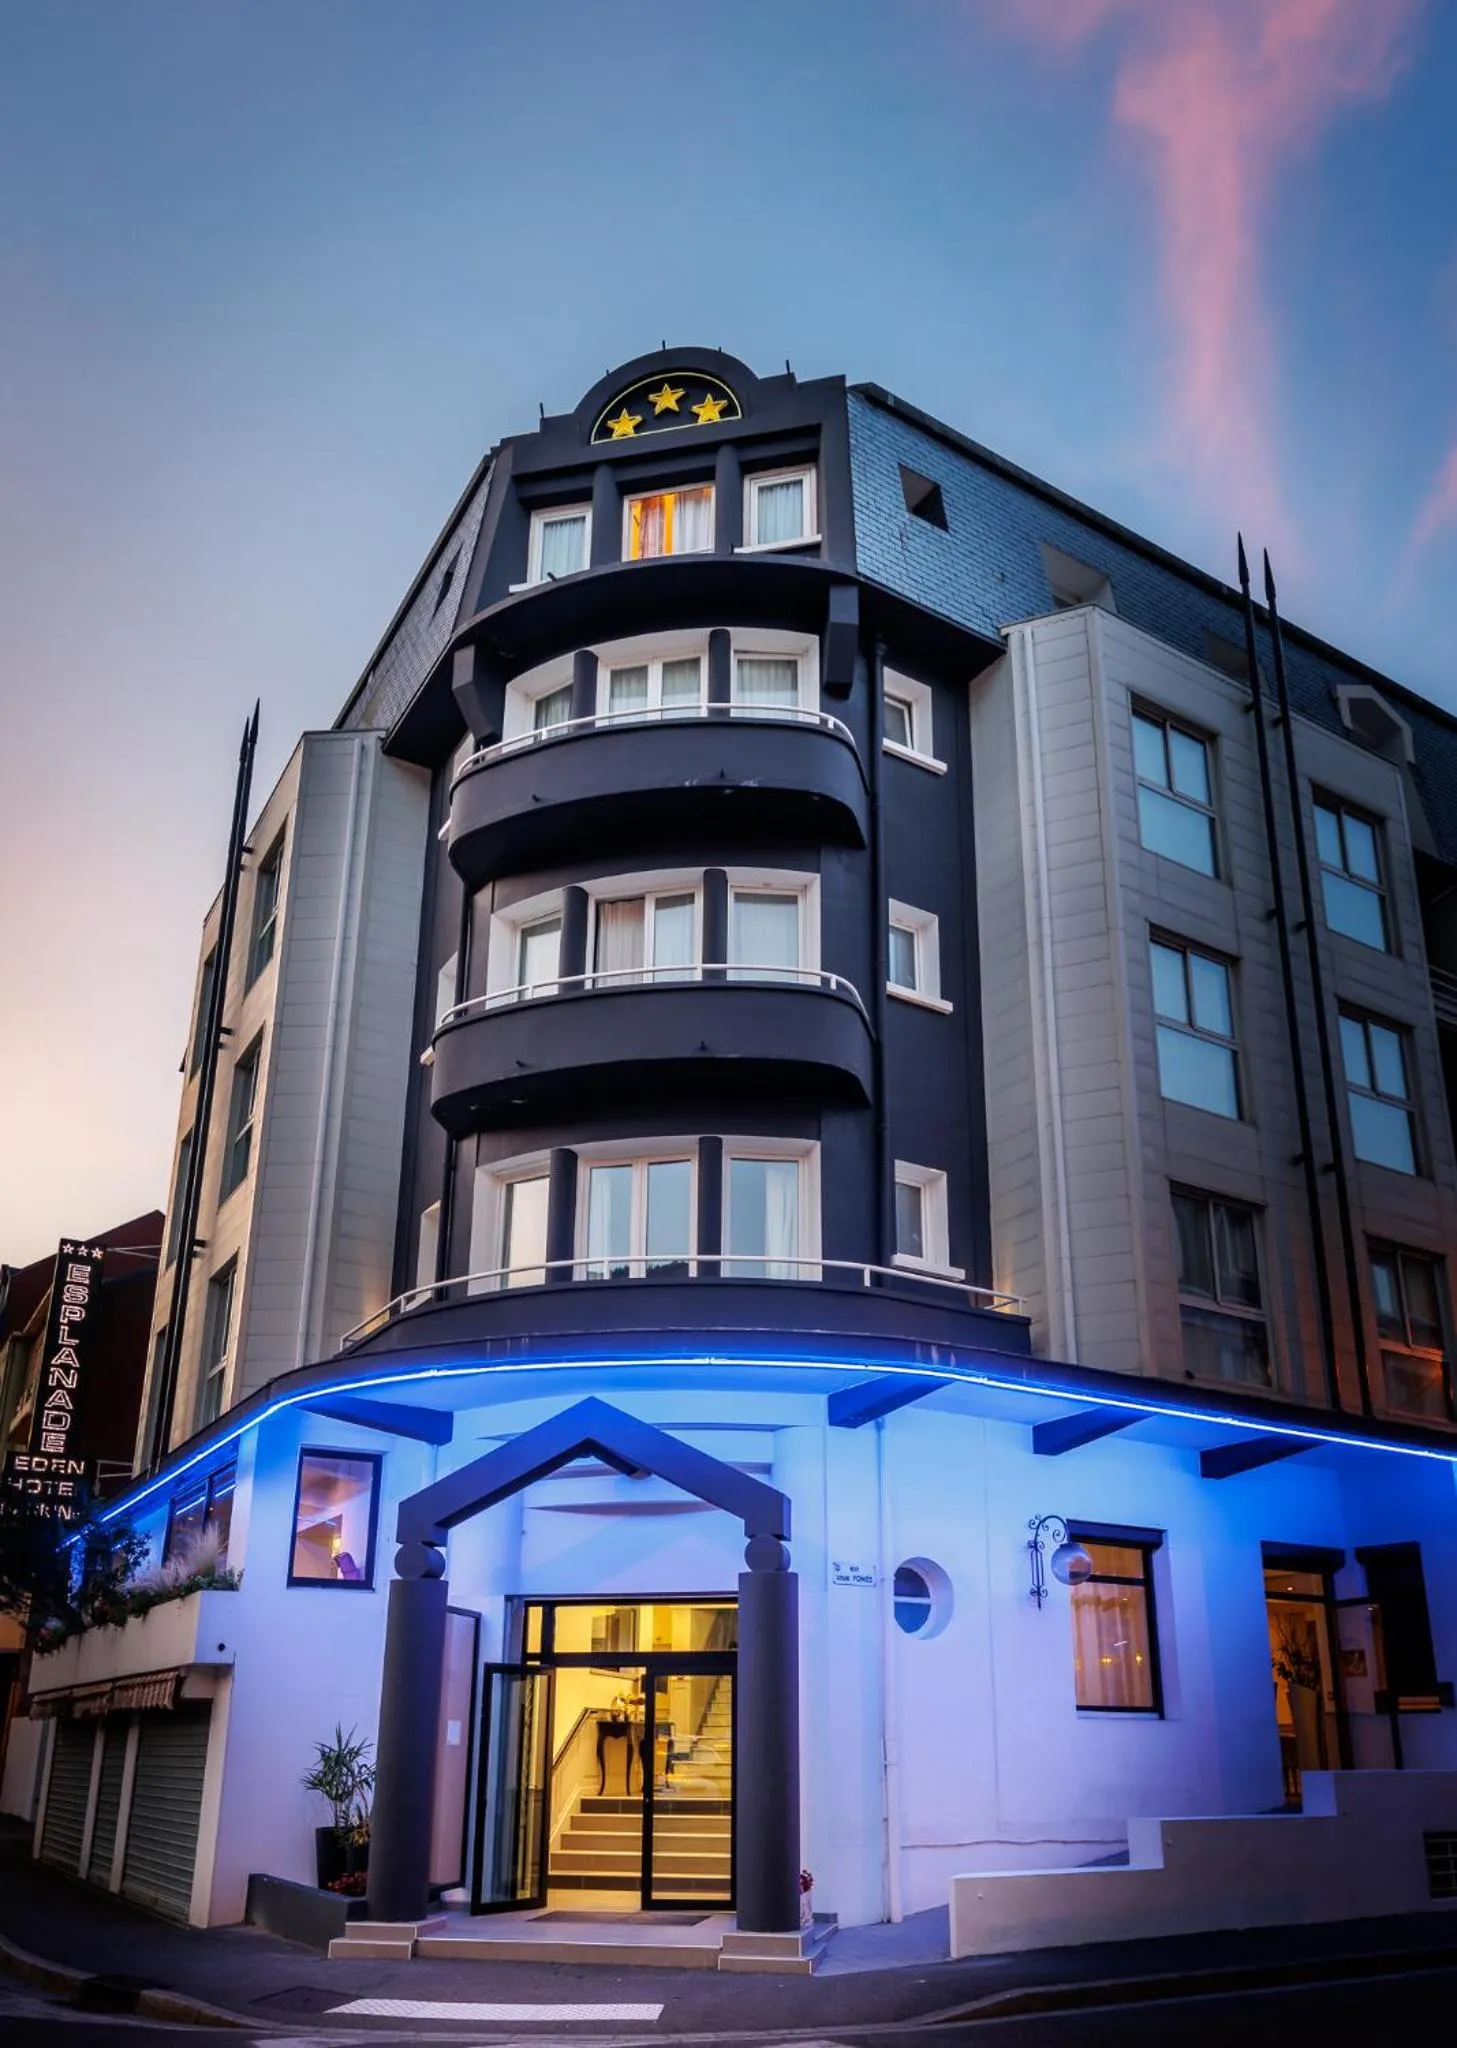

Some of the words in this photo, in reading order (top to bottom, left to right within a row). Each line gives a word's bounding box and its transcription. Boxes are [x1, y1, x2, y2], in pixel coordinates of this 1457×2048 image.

[40, 1263, 92, 1453] ESPLANADE
[14, 1455, 85, 1475] EDEN
[7, 1476, 76, 1497] HOTE
